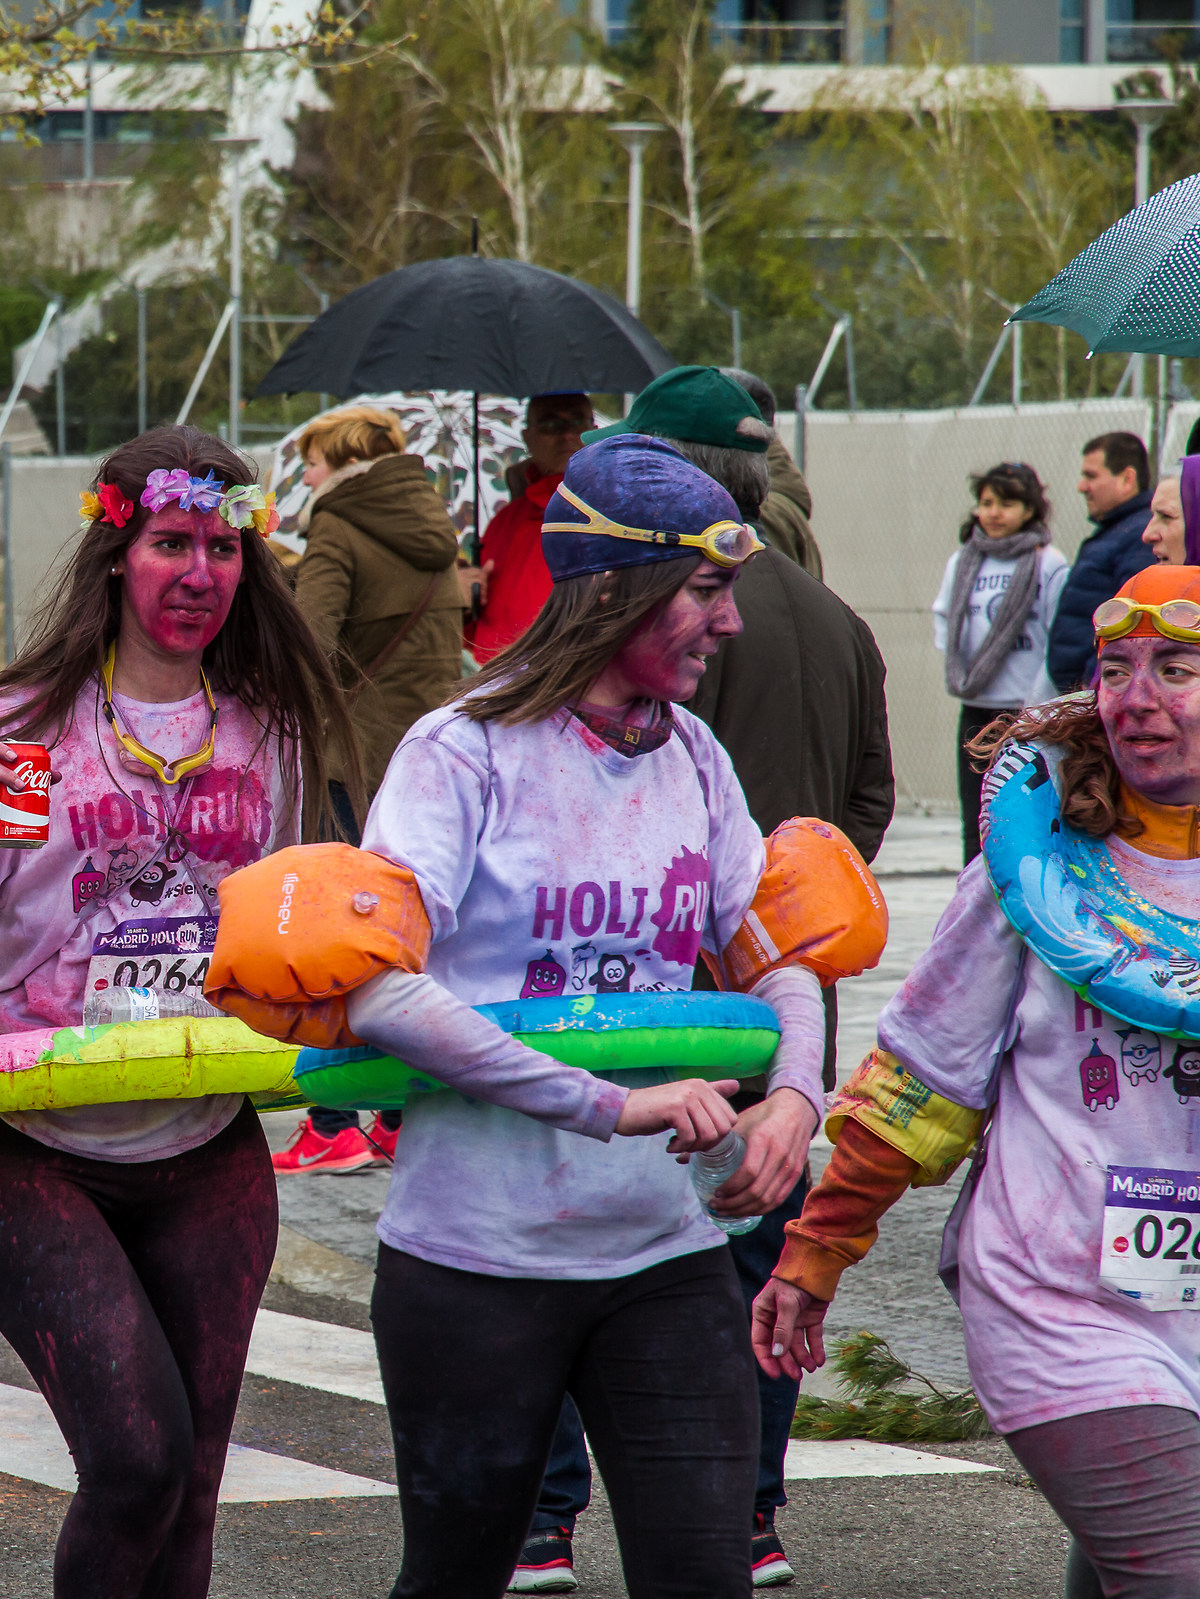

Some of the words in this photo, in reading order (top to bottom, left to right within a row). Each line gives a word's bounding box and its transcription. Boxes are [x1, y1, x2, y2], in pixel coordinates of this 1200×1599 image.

[67, 790, 168, 851] HOLI
[191, 791, 262, 843] RUN
[277, 872, 299, 935] nabaiji
[531, 881, 649, 941] HOLI
[665, 881, 708, 932] RU
[99, 933, 150, 946] MADRID
[151, 930, 176, 947] HOLI
[180, 930, 198, 943] RUN
[113, 957, 211, 995] 0264
[1112, 1175, 1176, 1196] MADRID
[1177, 1185, 1200, 1202] HO
